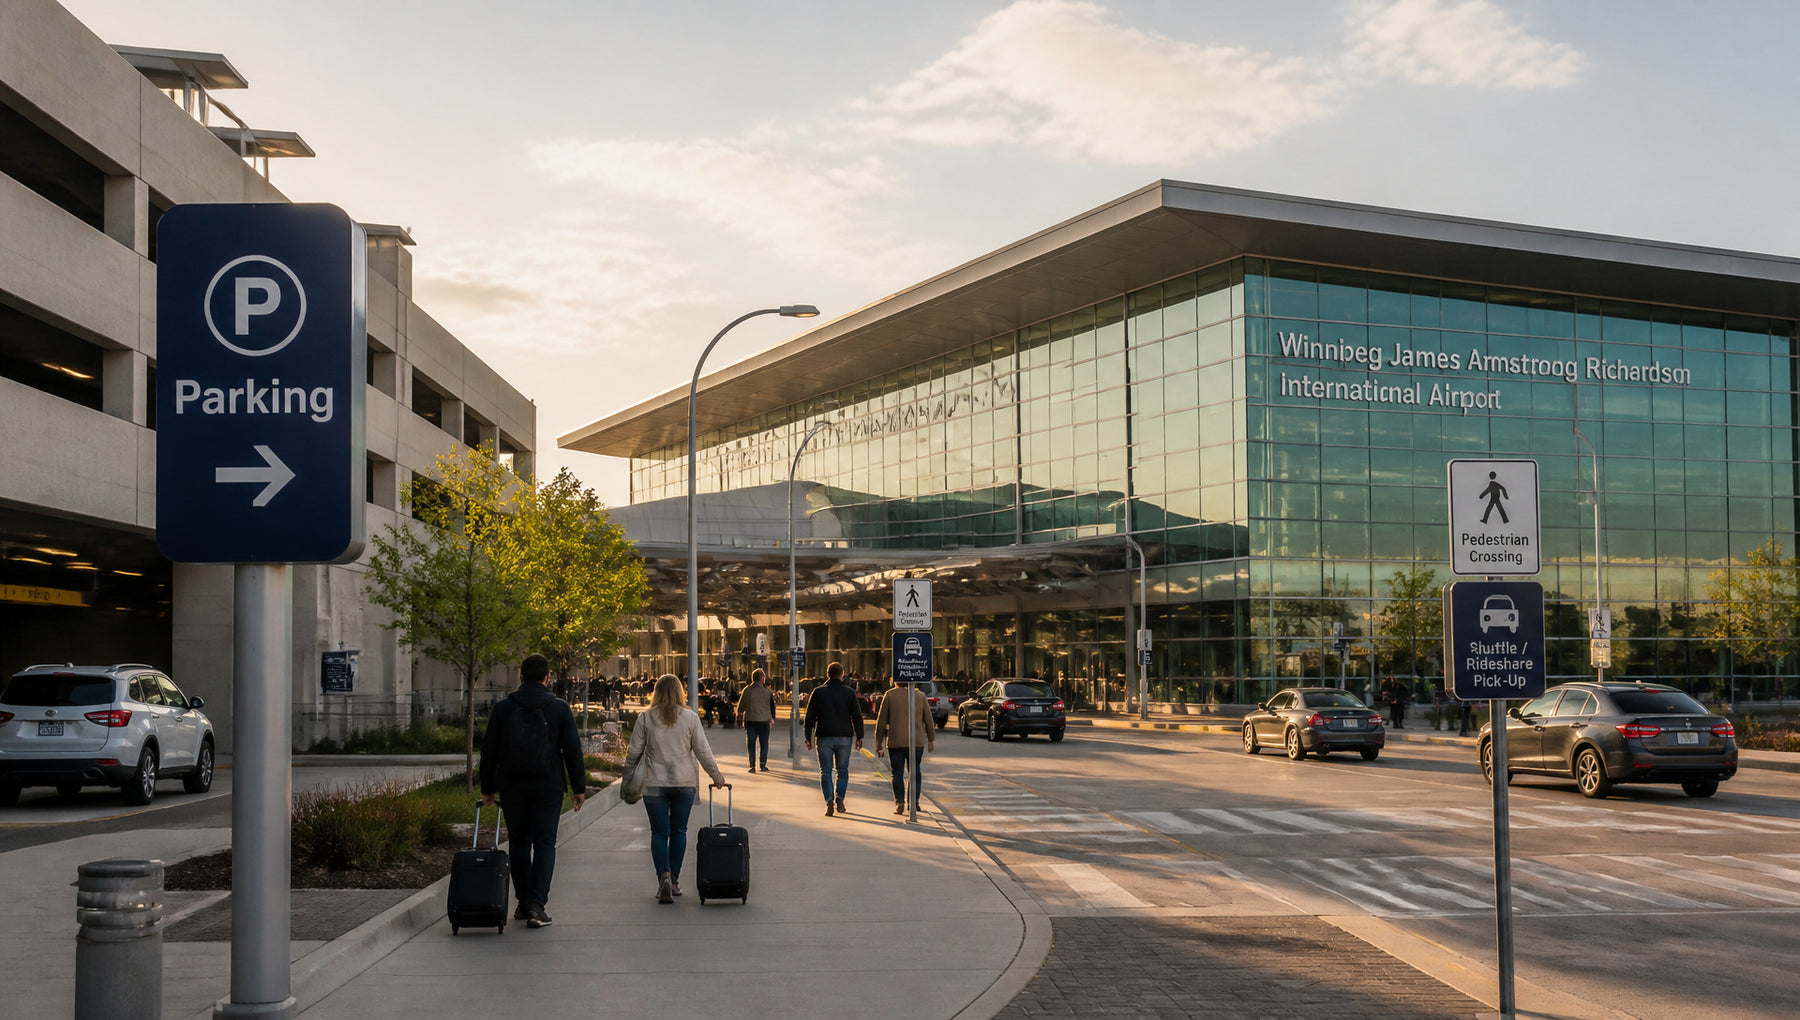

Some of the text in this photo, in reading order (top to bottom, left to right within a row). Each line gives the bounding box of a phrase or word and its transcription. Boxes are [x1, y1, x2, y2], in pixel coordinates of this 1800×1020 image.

[235, 276, 282, 335] P
[1278, 331, 1382, 370] Winnipeg
[1389, 342, 1461, 370] James
[175, 378, 334, 423] Parking
[1428, 383, 1502, 417] Airport
[1461, 532, 1529, 546] Pedestrian
[1469, 549, 1523, 566] Crossing
[1469, 640, 1518, 655] Shuttle
[1466, 656, 1534, 671] Rideshare
[1473, 673, 1527, 689] Pick-Up
